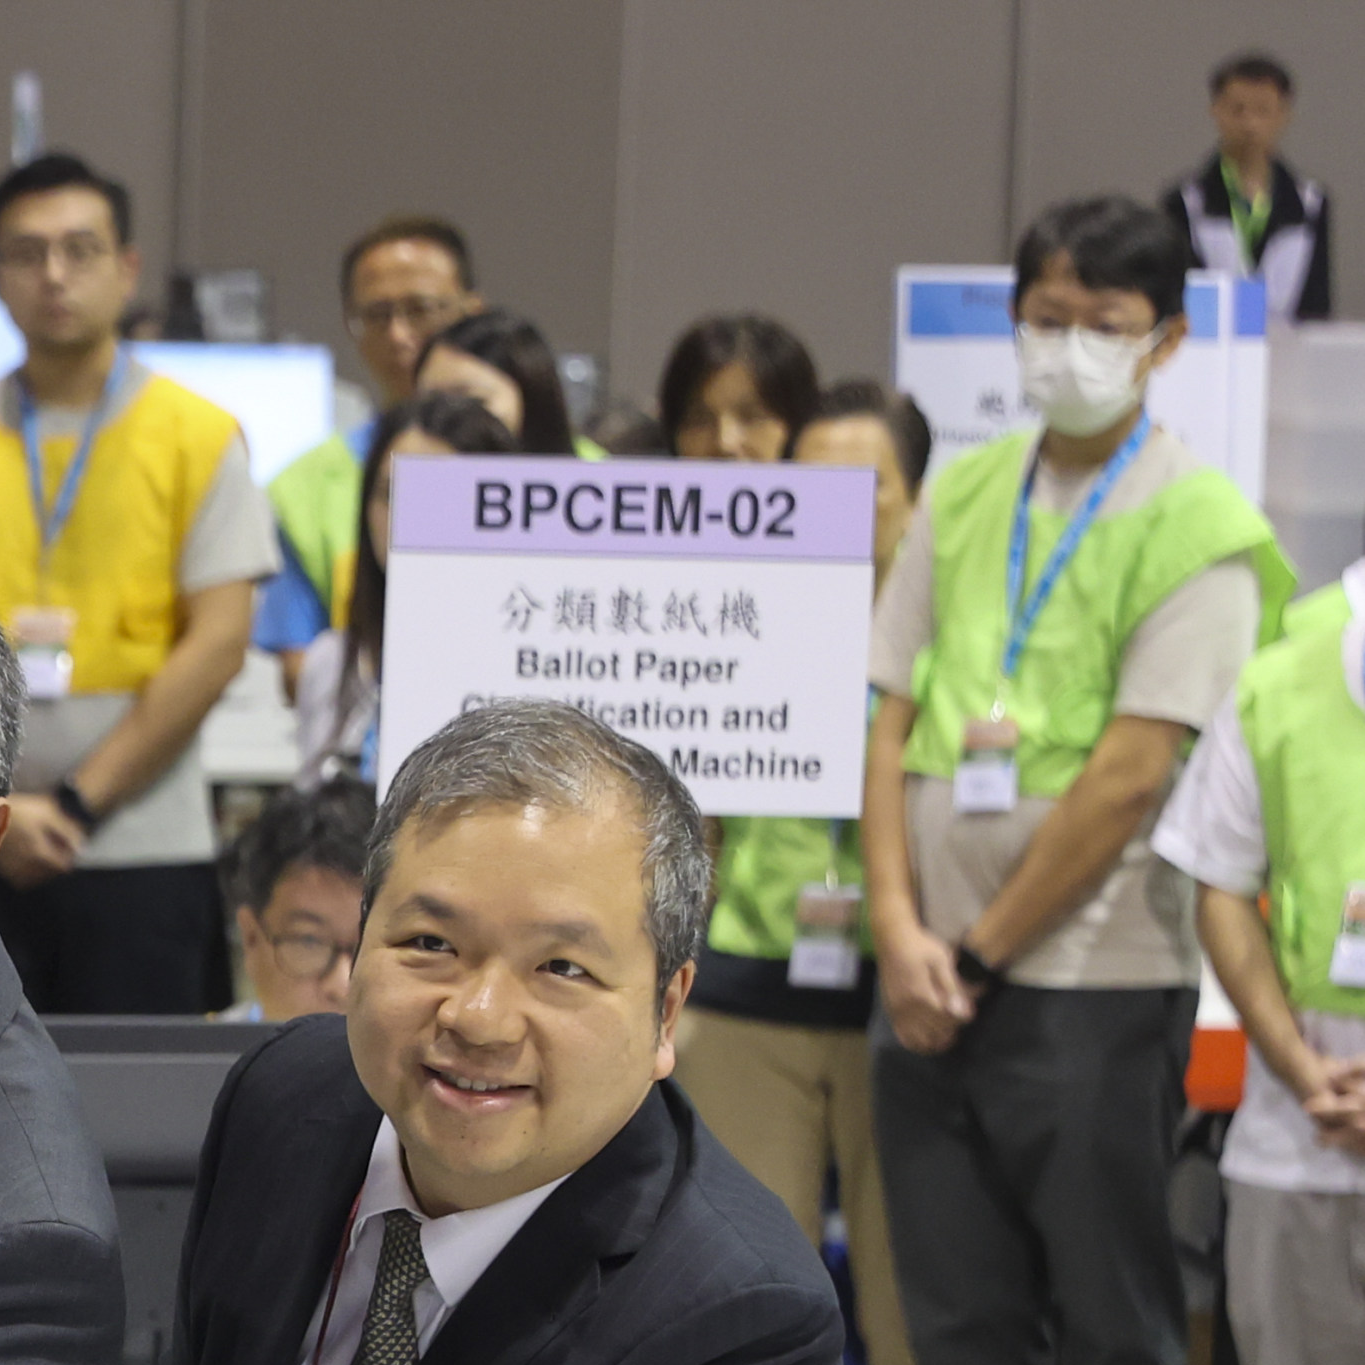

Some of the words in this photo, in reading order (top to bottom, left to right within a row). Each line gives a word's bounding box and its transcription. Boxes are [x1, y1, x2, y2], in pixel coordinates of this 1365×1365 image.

[474, 479, 797, 539] BPCEM-02
[500, 586, 763, 641] 分類數紙機
[516, 648, 622, 681] Ballot
[635, 651, 740, 689] Paper
[722, 703, 789, 733] and
[671, 748, 822, 782] Machine
